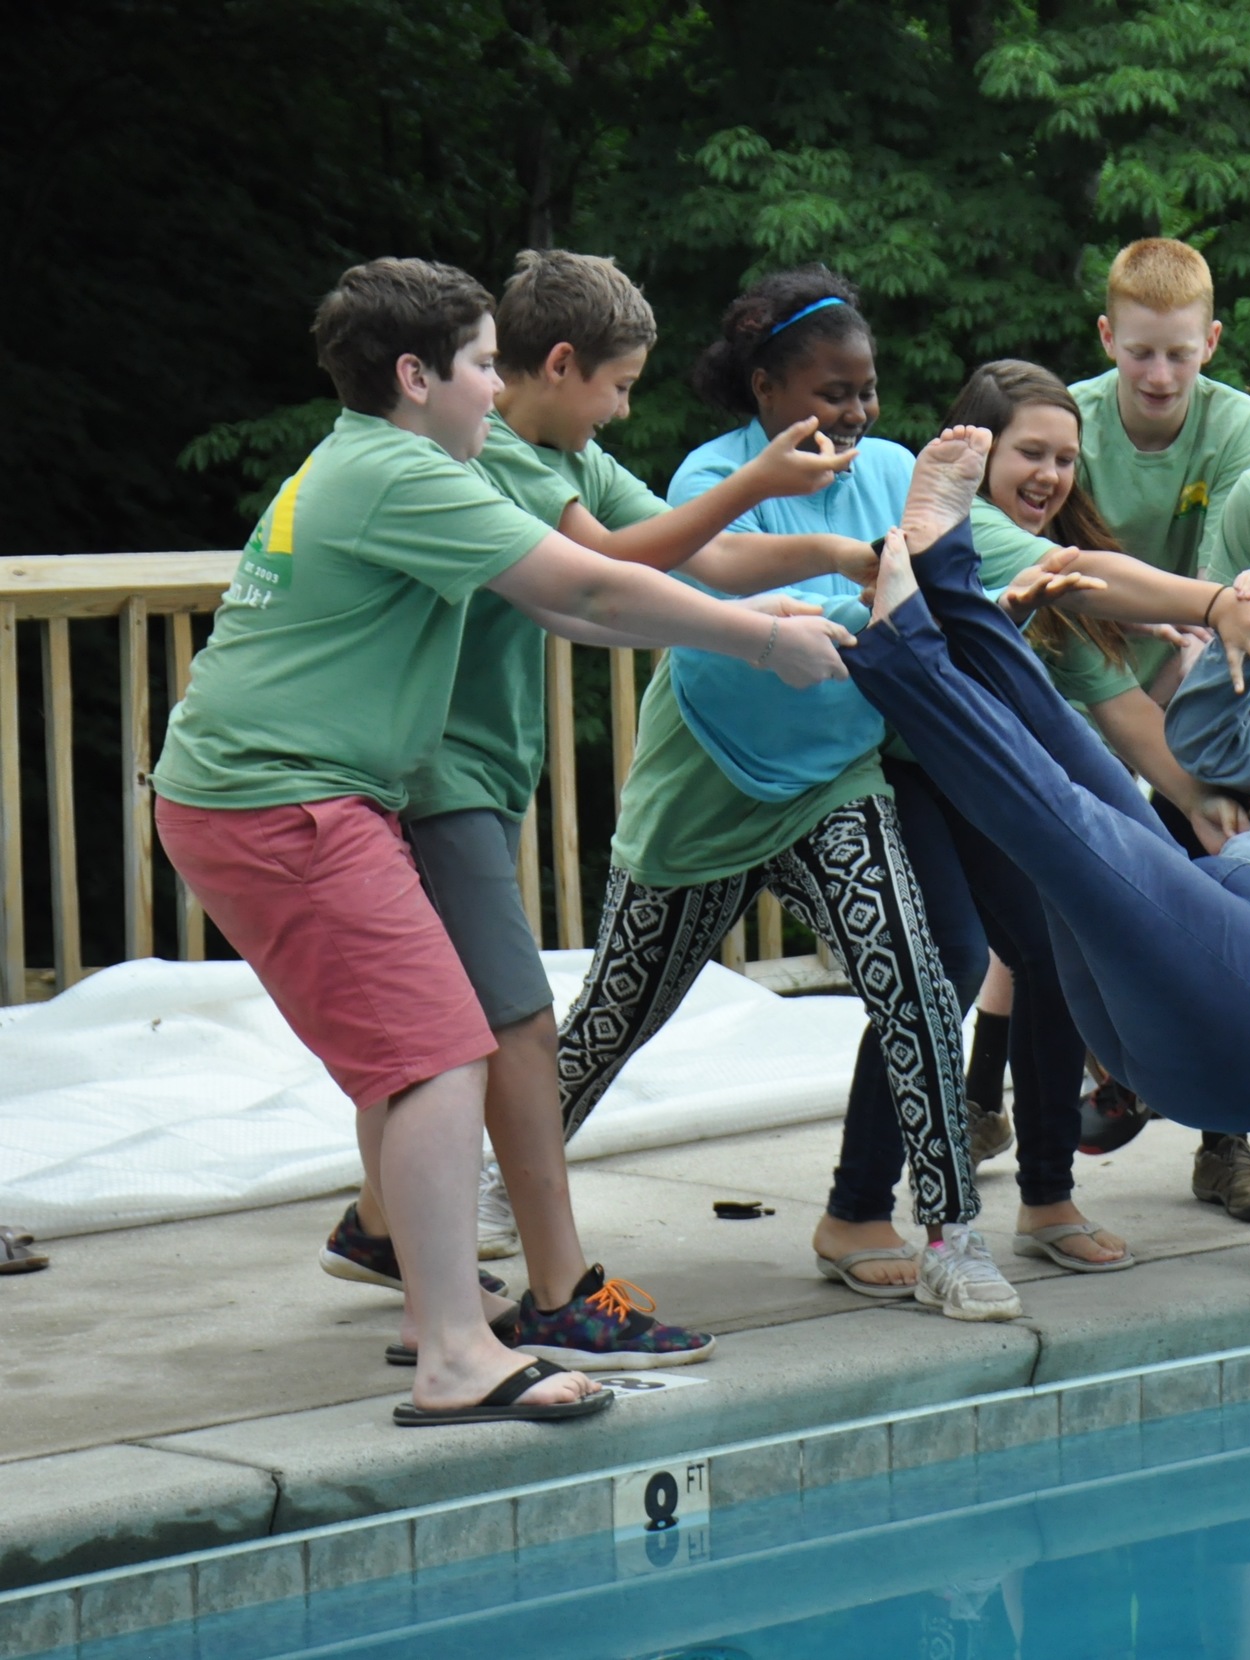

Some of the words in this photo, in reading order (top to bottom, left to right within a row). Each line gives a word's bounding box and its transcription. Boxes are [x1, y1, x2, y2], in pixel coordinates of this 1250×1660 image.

[254, 566, 279, 584] 2003
[595, 1377, 666, 1390] 8
[686, 1463, 705, 1493] FT
